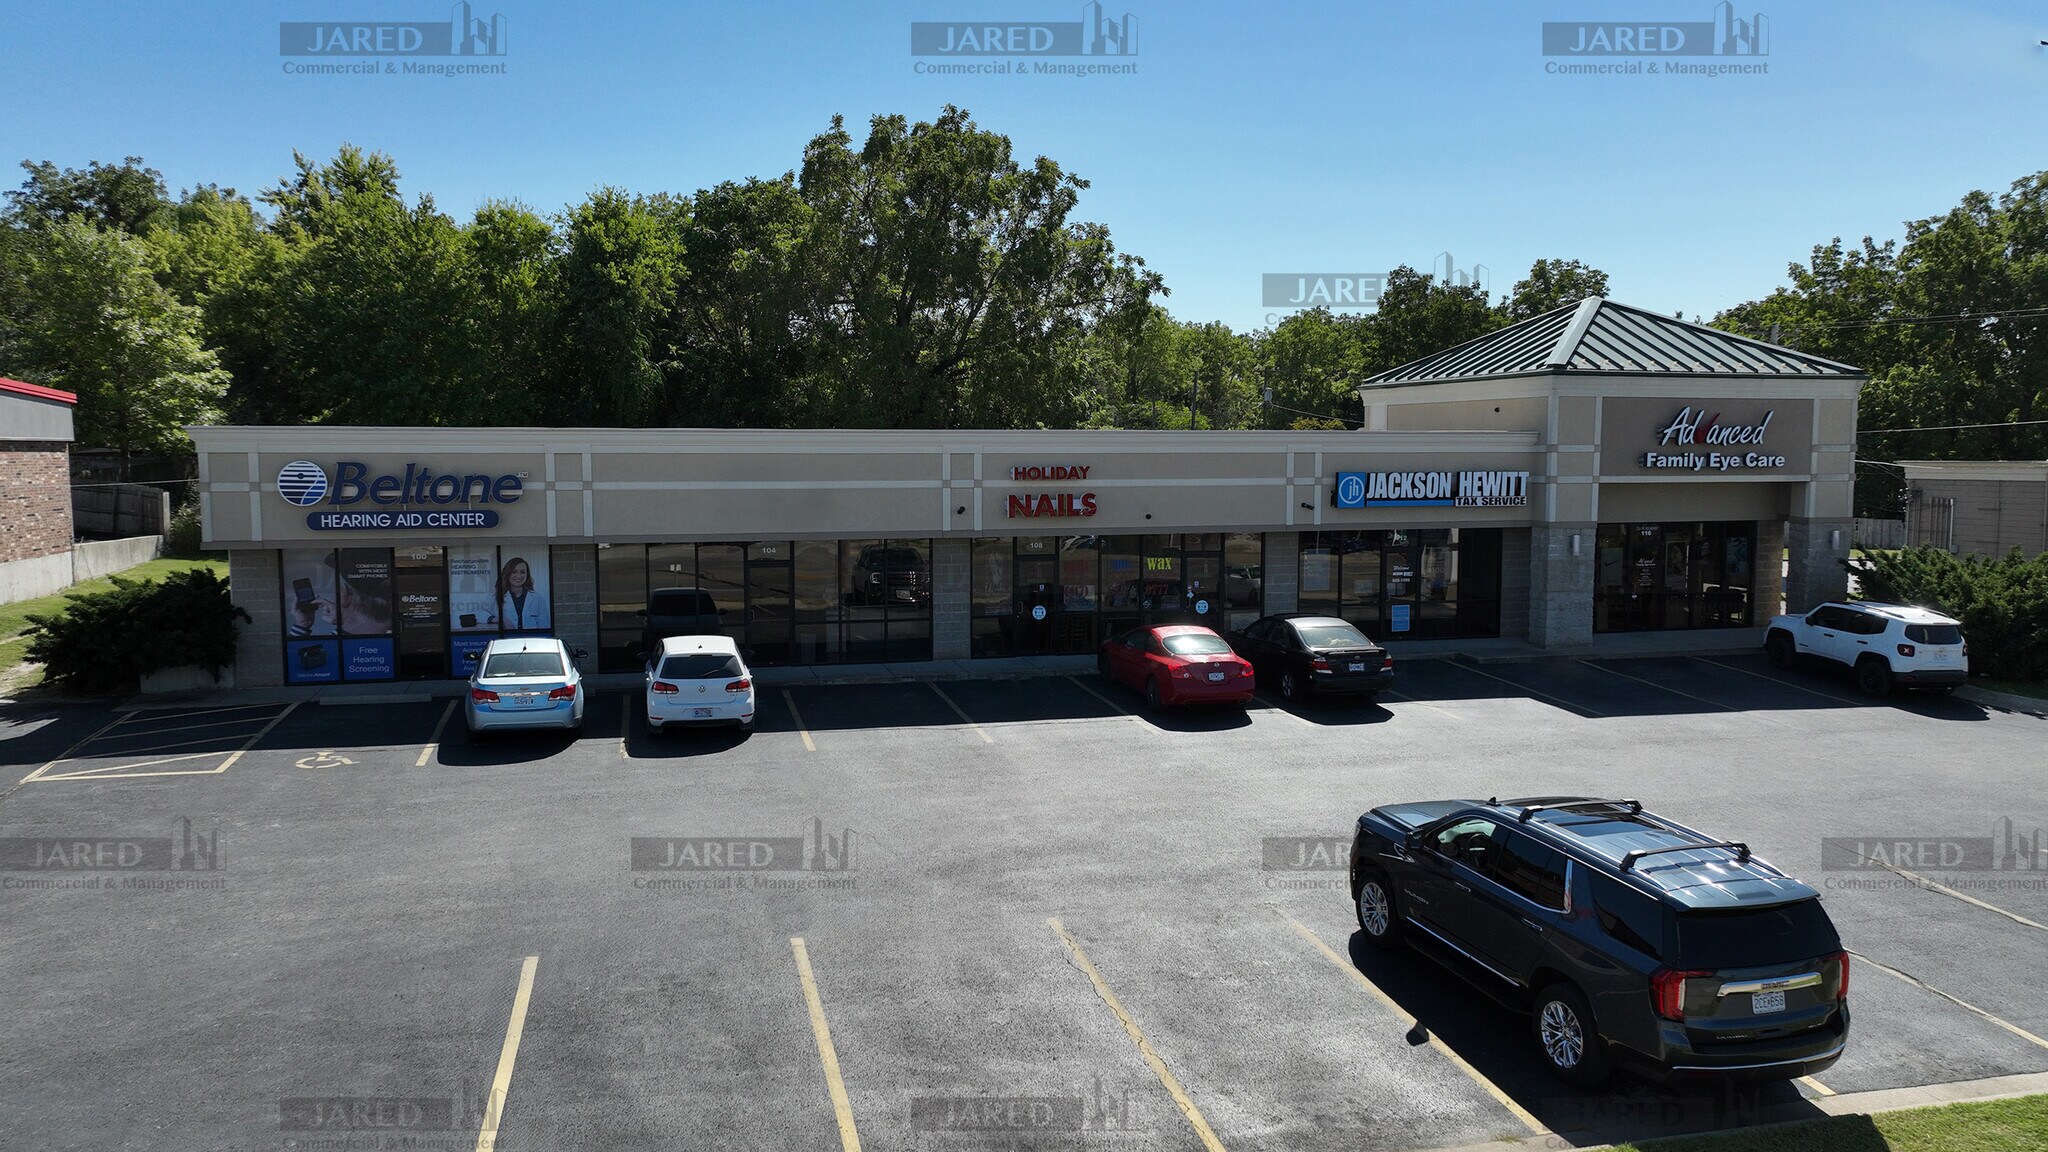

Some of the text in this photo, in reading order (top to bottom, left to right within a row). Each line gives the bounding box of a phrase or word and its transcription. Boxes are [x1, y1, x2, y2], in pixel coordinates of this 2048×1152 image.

[1646, 453, 1786, 471] Family Eye Care
[1013, 466, 1090, 481] HOLIDAY
[329, 462, 524, 505] Beltone
[1366, 471, 1530, 499] JACKSON HEWITT
[1007, 493, 1097, 518] NAILS
[1456, 496, 1527, 506] TAX SERVICE
[321, 512, 485, 529] HEARING AID CENTER
[1146, 556, 1172, 570] wax
[353, 656, 384, 664] Hearing
[349, 665, 390, 673] Screening
